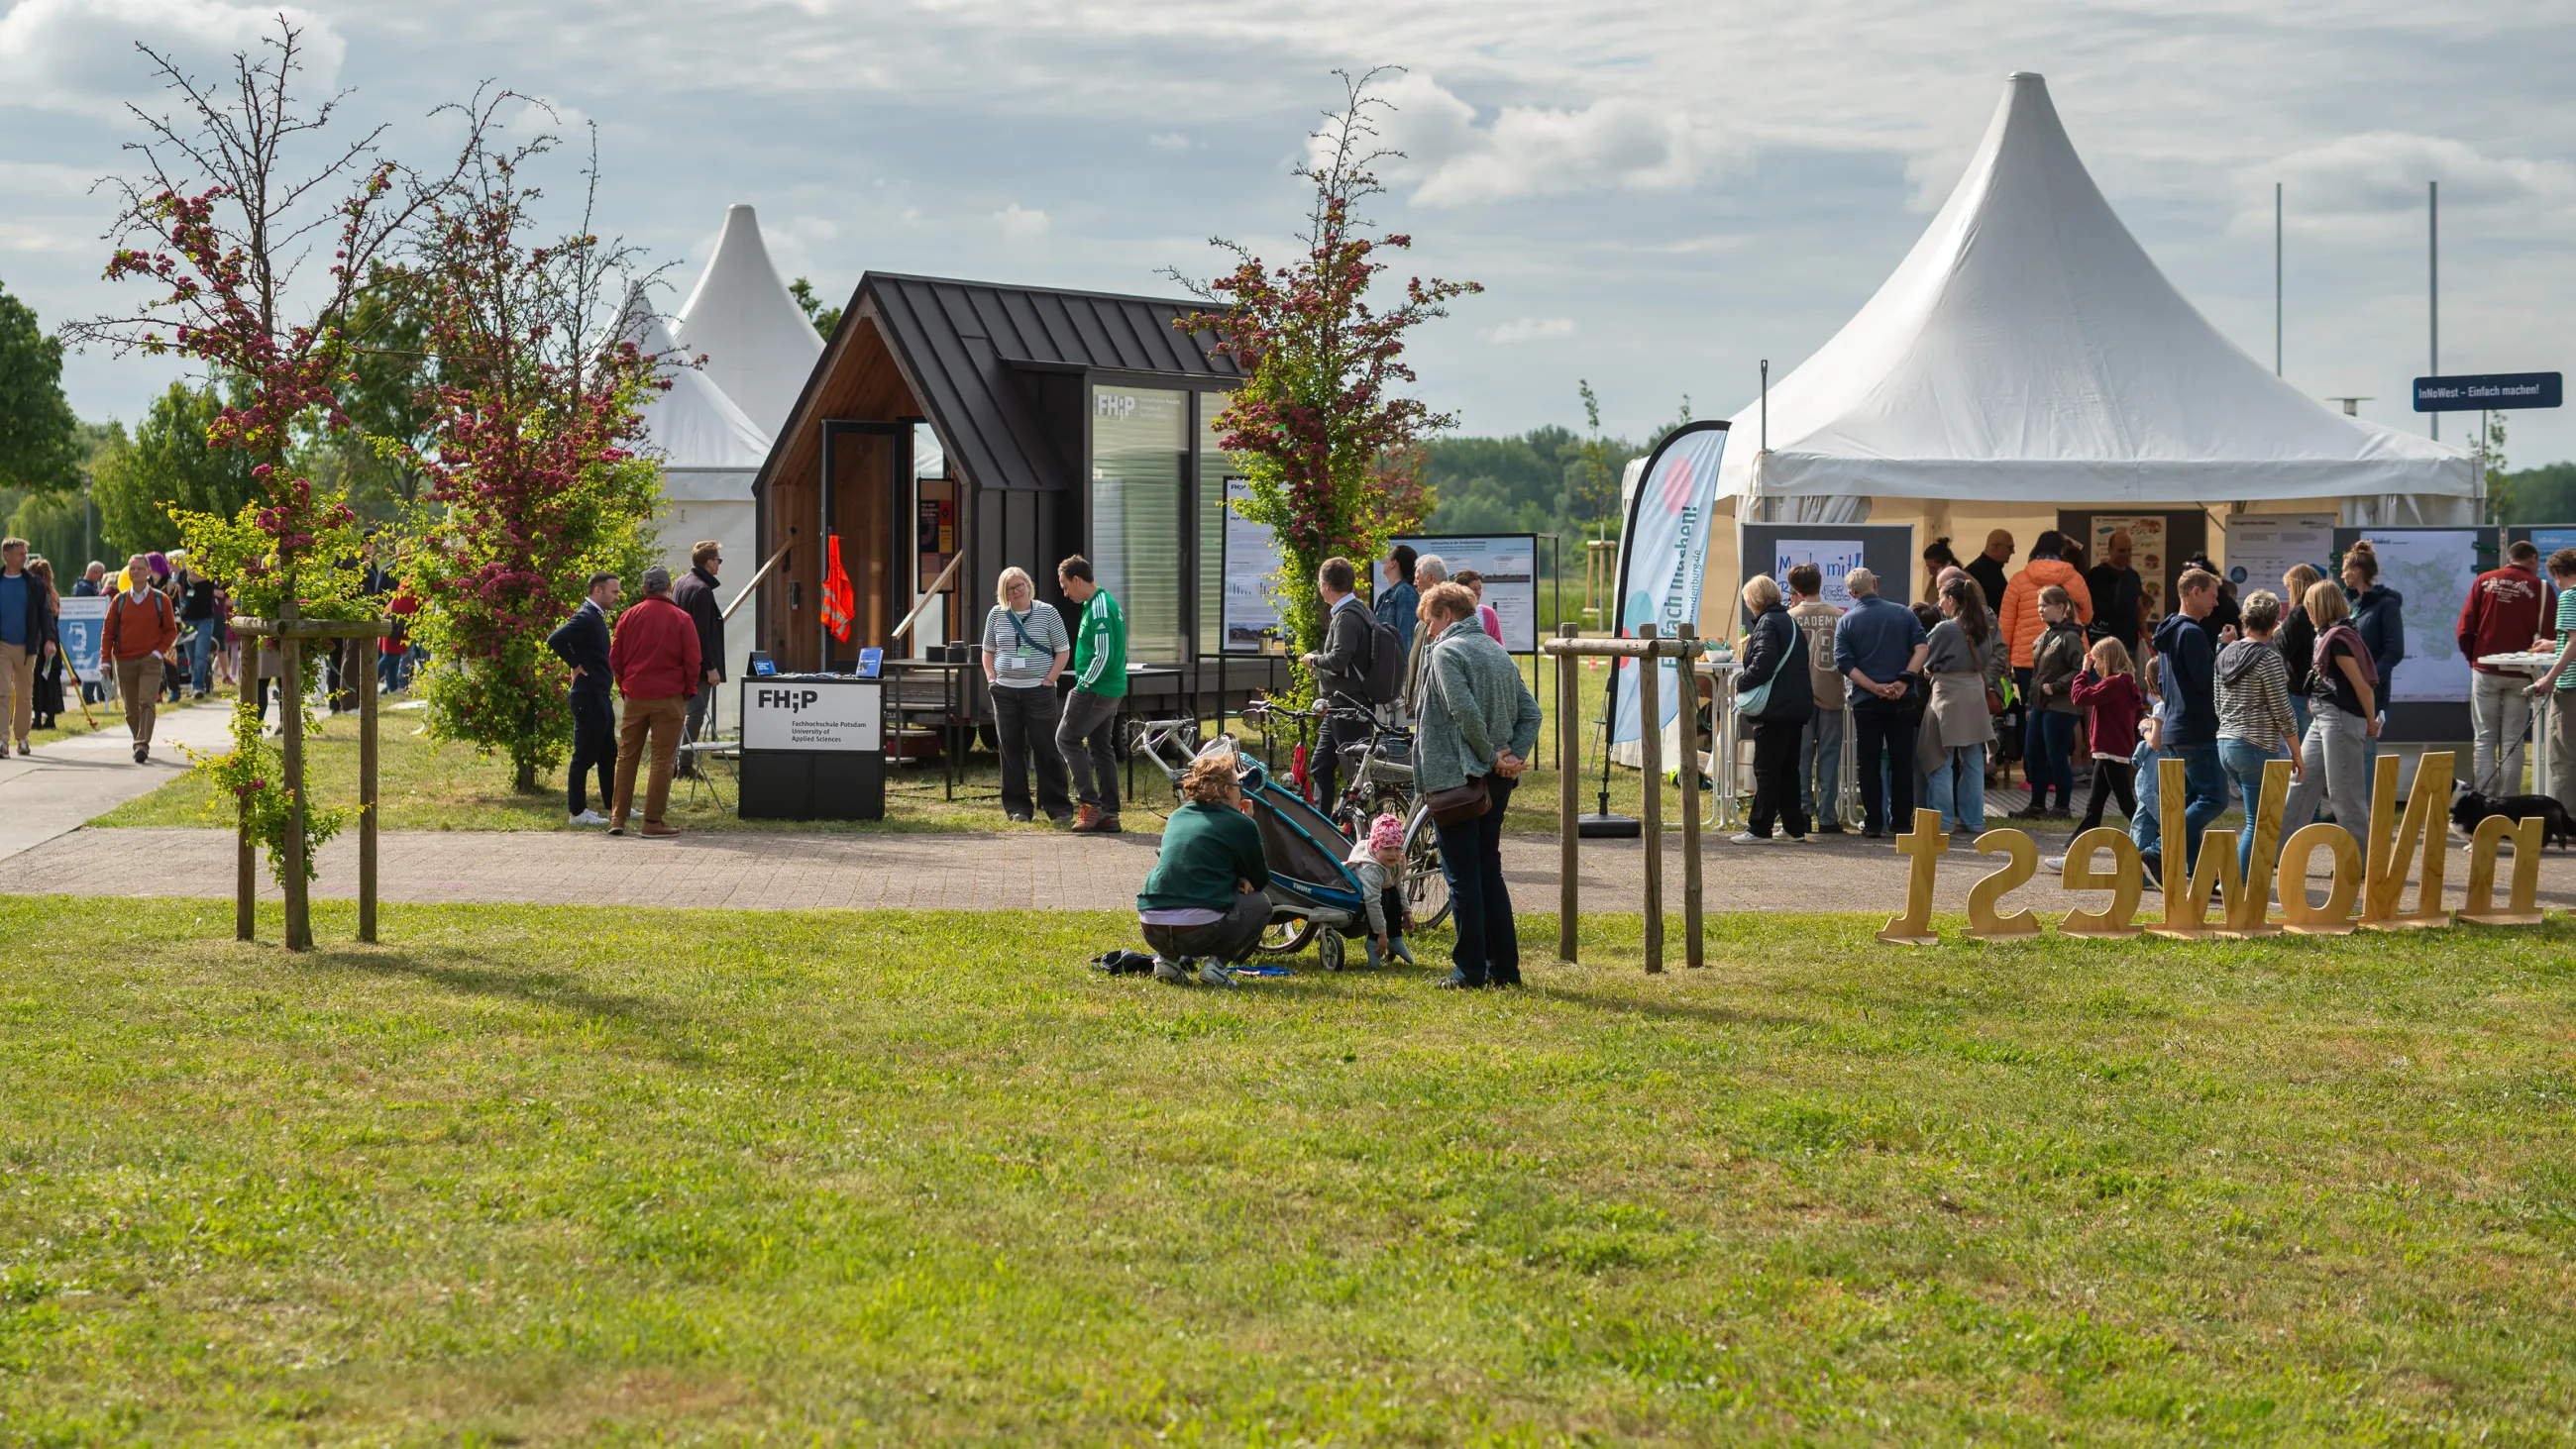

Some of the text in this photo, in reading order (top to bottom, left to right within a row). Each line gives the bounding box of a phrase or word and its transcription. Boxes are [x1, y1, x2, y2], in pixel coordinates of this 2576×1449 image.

[2418, 387, 2459, 398] InNoWest
[2468, 385, 2500, 397] Einfach
[2502, 384, 2539, 396] machen!
[1796, 615, 1840, 627] CADEM
[1661, 596, 1682, 669] Efach
[758, 689, 818, 714] FH;P
